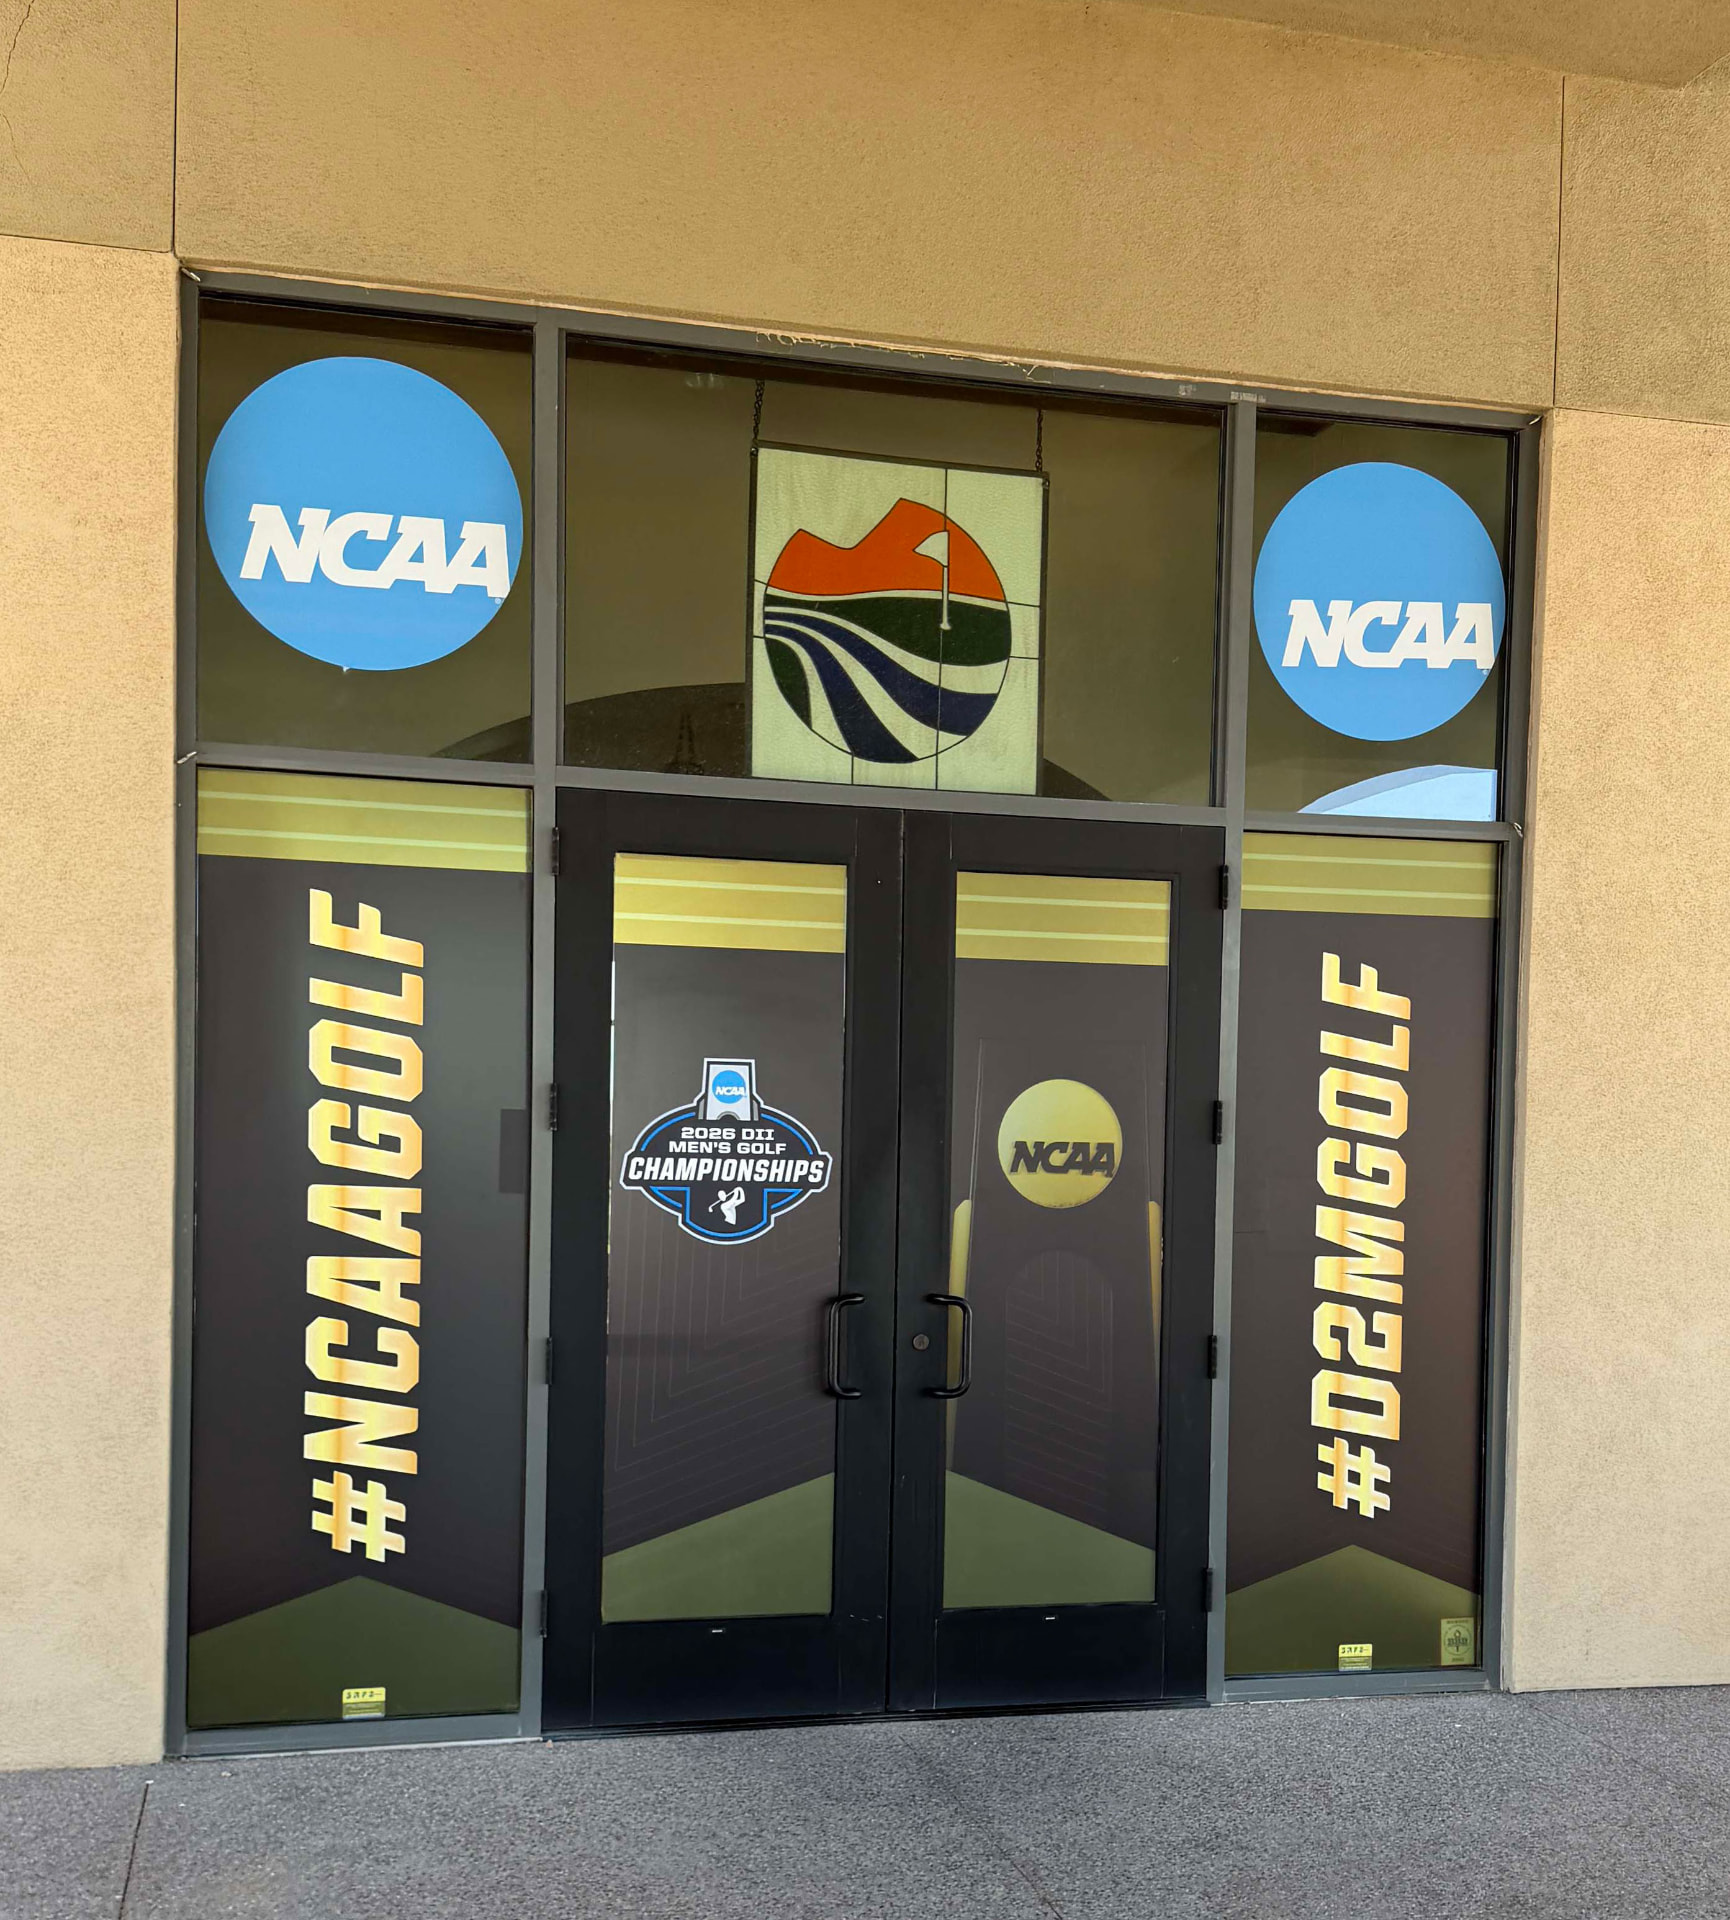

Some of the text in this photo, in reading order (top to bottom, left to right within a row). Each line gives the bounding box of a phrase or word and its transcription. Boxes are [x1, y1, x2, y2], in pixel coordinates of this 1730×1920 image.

[240, 503, 510, 598] NCAA
[1282, 599, 1495, 669] NCAA
[715, 1086, 746, 1096] NCAA
[668, 1140, 787, 1155] MEN'S GOLF
[680, 1127, 775, 1141] 2026 DII
[628, 1157, 825, 1184] CHAMPIONSHIPS
[1010, 1140, 1116, 1178] NCAA
[303, 888, 424, 1562] #NCAAGOLF
[1311, 951, 1411, 1519] #D2MGOLF
